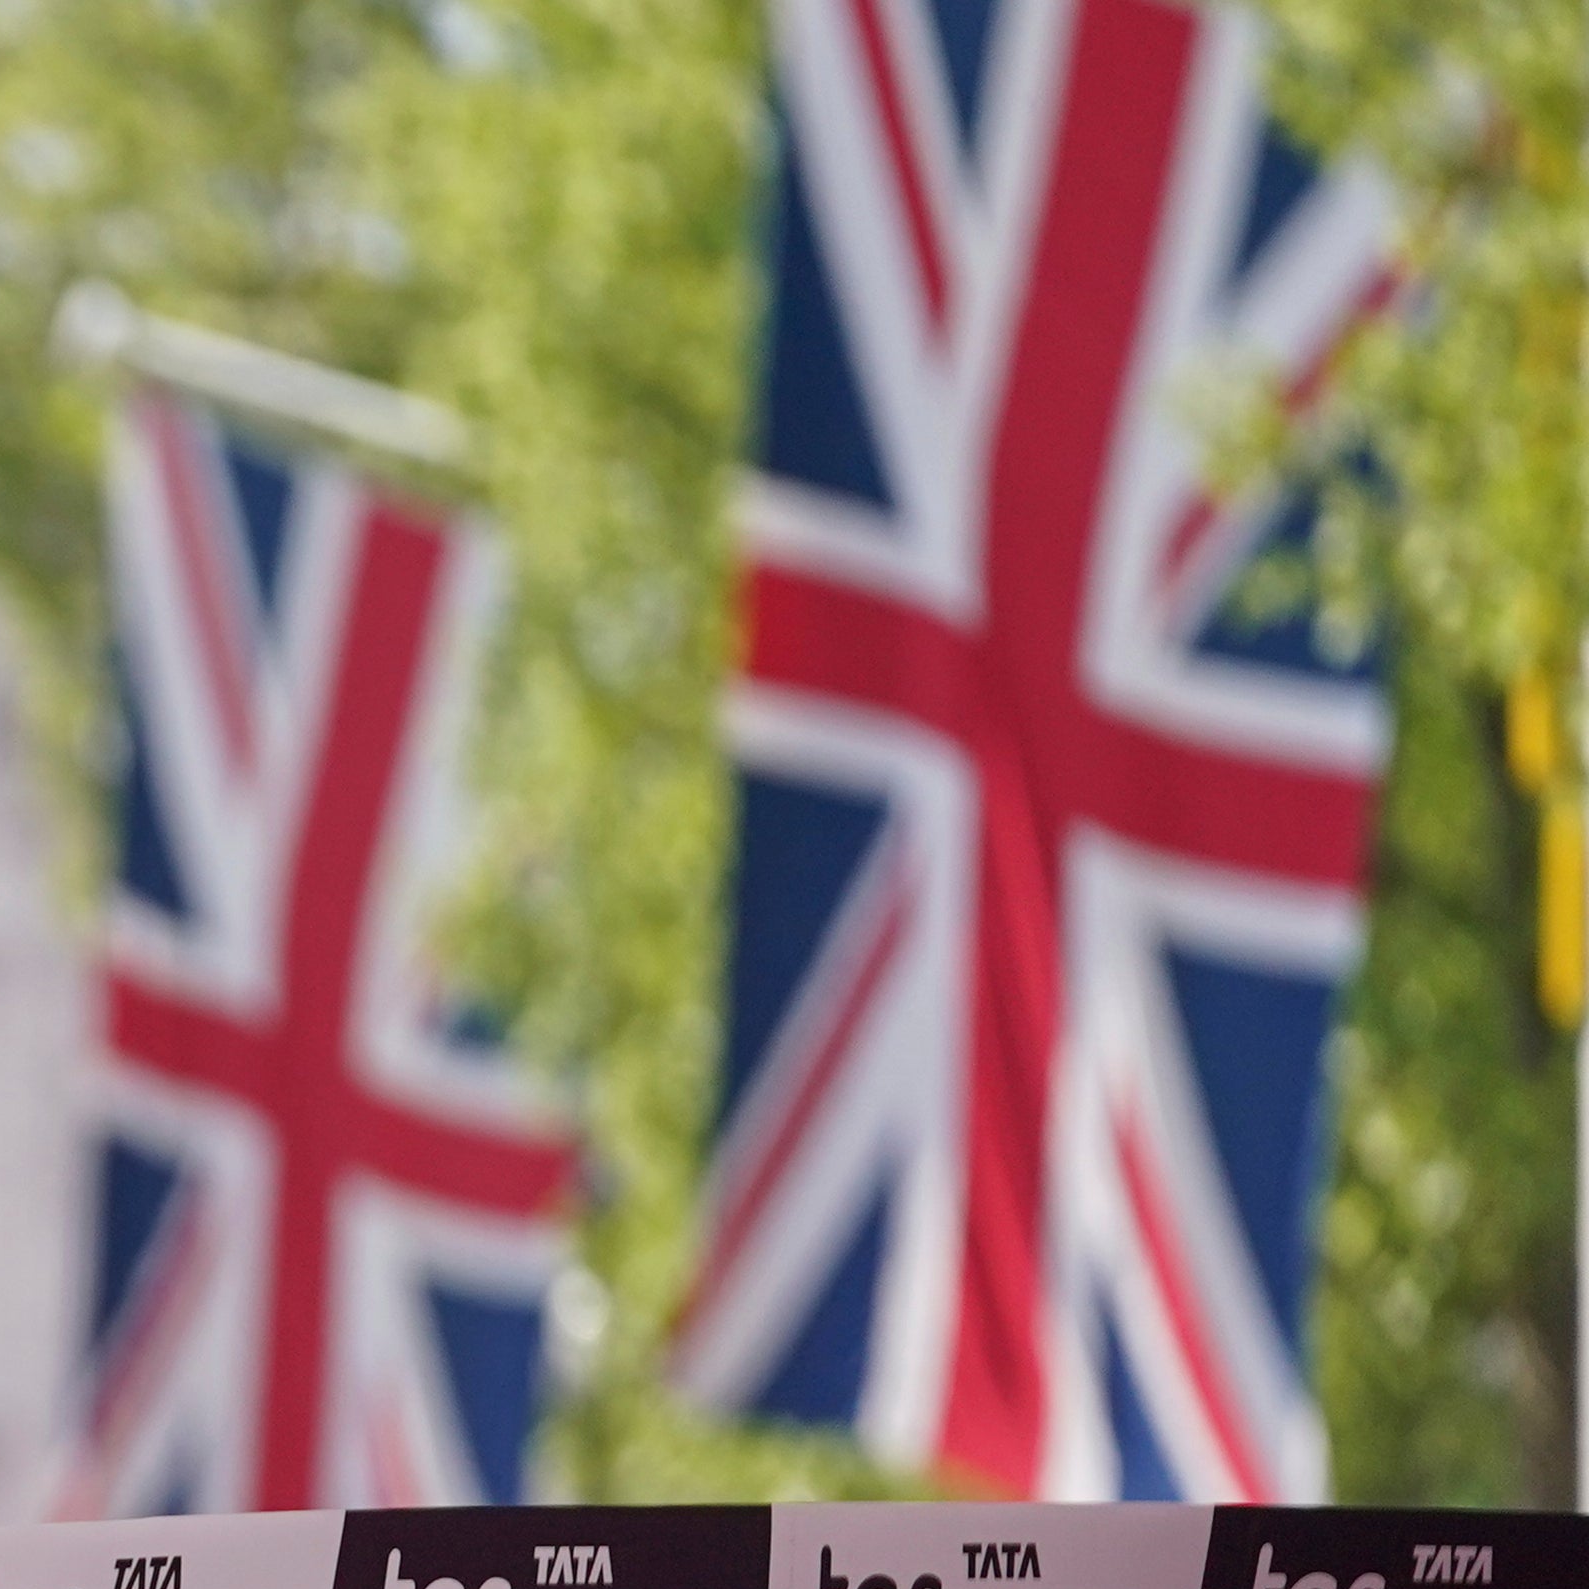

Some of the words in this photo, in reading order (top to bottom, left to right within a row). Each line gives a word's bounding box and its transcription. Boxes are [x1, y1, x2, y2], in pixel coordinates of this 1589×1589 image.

[533, 1545, 614, 1585] TATA
[962, 1542, 1042, 1580] TATA
[1412, 1544, 1494, 1584] TATA
